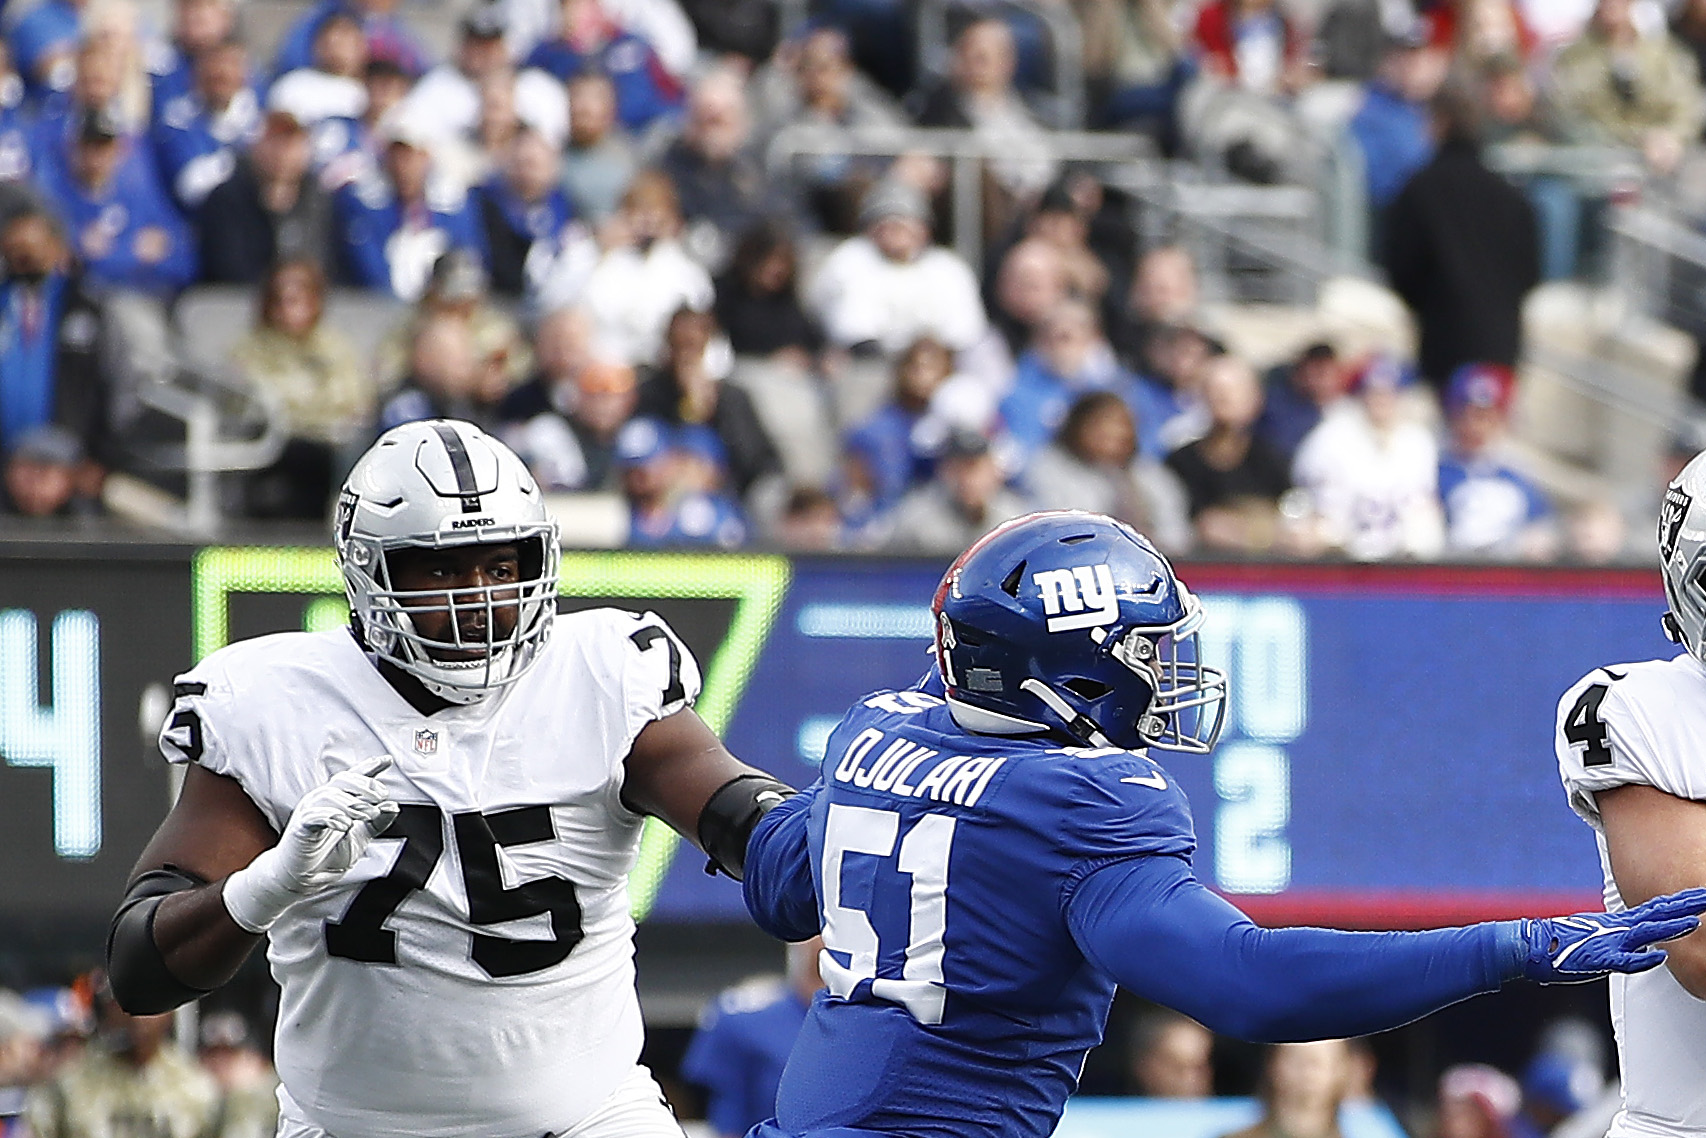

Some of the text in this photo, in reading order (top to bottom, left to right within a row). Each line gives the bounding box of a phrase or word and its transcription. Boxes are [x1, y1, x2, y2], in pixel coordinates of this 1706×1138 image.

[452, 517, 496, 531] RAIDERS
[416, 738, 436, 752] NFL
[834, 727, 1008, 808] OJULARI
[1564, 683, 1613, 768] 4
[1213, 741, 1294, 895] 2
[325, 803, 585, 978] 75
[818, 803, 958, 1025] 51
